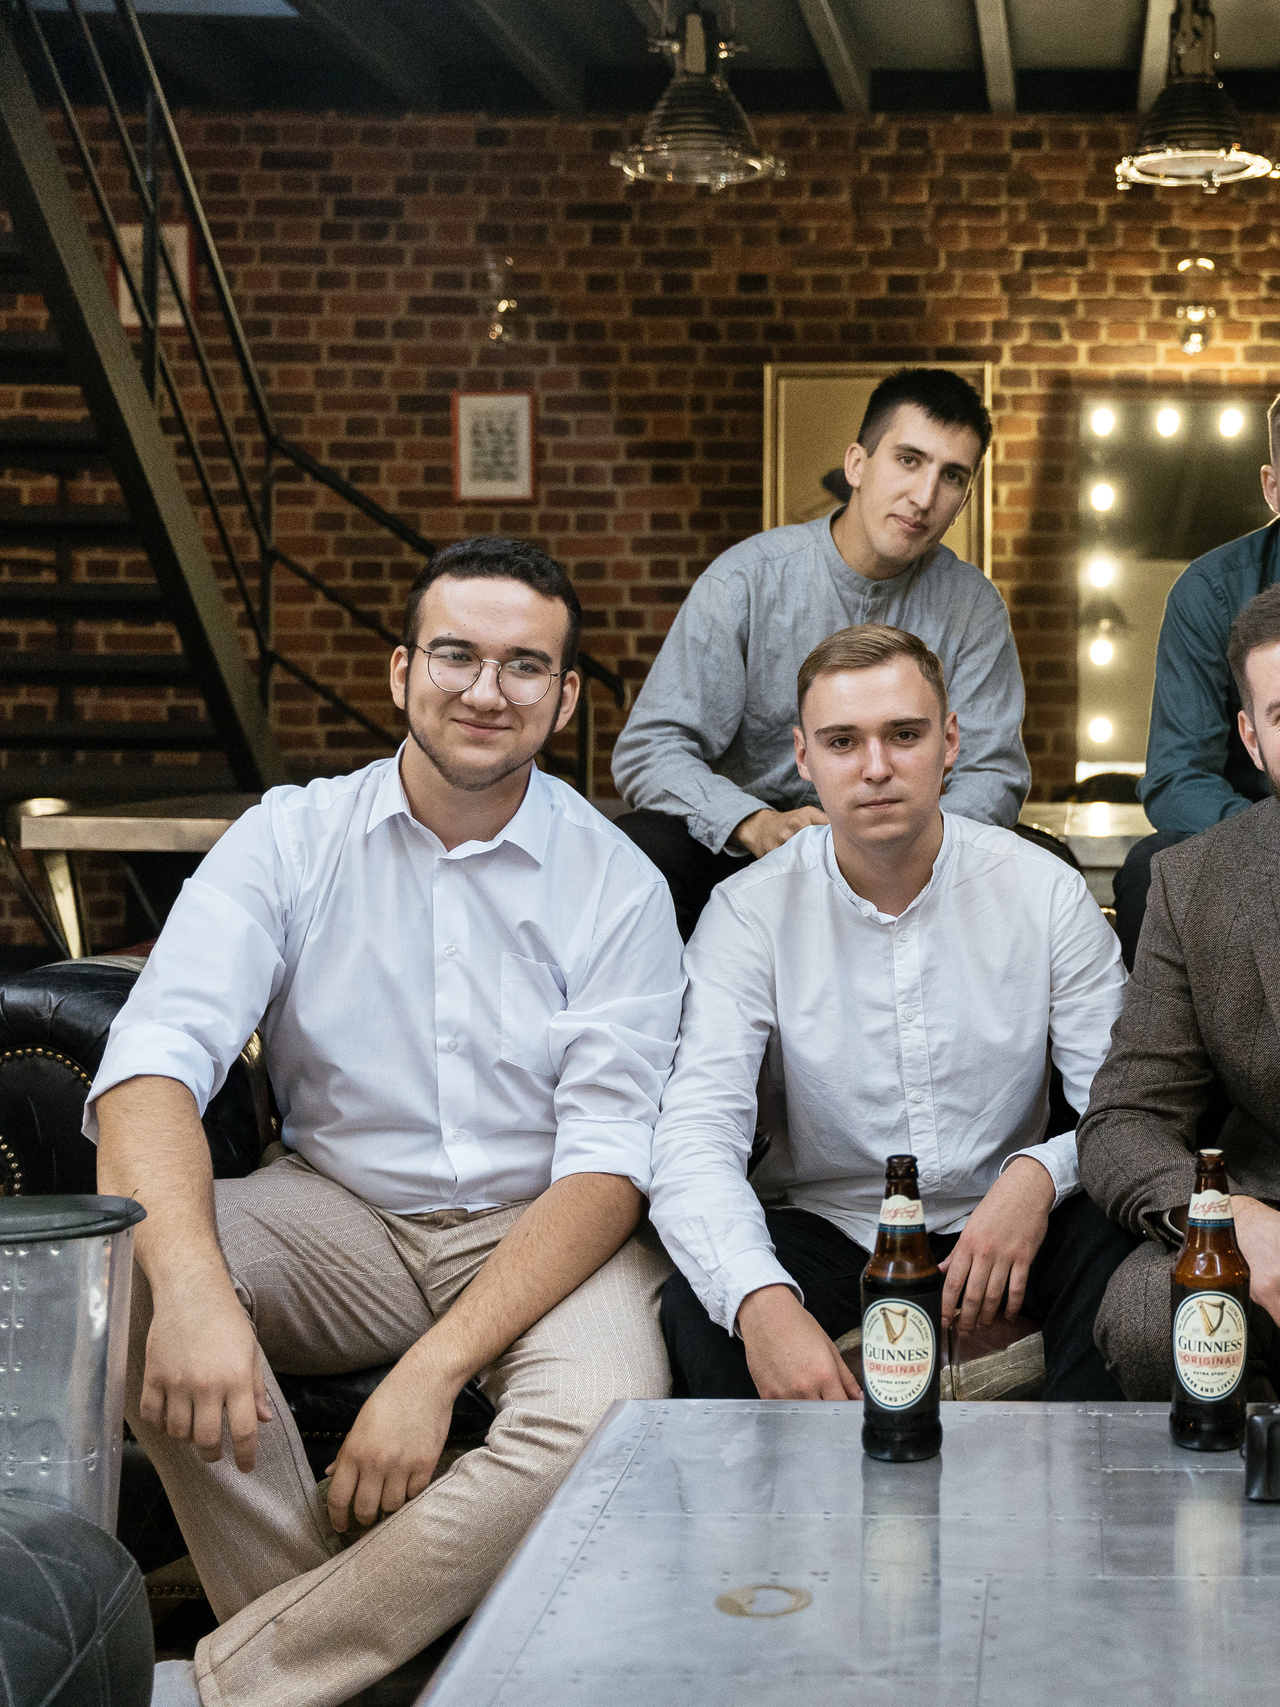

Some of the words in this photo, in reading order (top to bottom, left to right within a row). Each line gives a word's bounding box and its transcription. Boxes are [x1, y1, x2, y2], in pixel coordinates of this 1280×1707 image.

[865, 1342, 929, 1362] GUINNESS
[1178, 1335, 1243, 1353] GUINNESS
[869, 1361, 923, 1374] ORIGINAL
[1183, 1354, 1237, 1365] ORIGINAL
[869, 1380, 882, 1397] DARK
[883, 1395, 898, 1403] AND
[901, 1382, 922, 1402] LIVELY
[1183, 1372, 1198, 1389] DARK
[1199, 1386, 1215, 1394] AND
[1217, 1374, 1236, 1393] LIVELY
